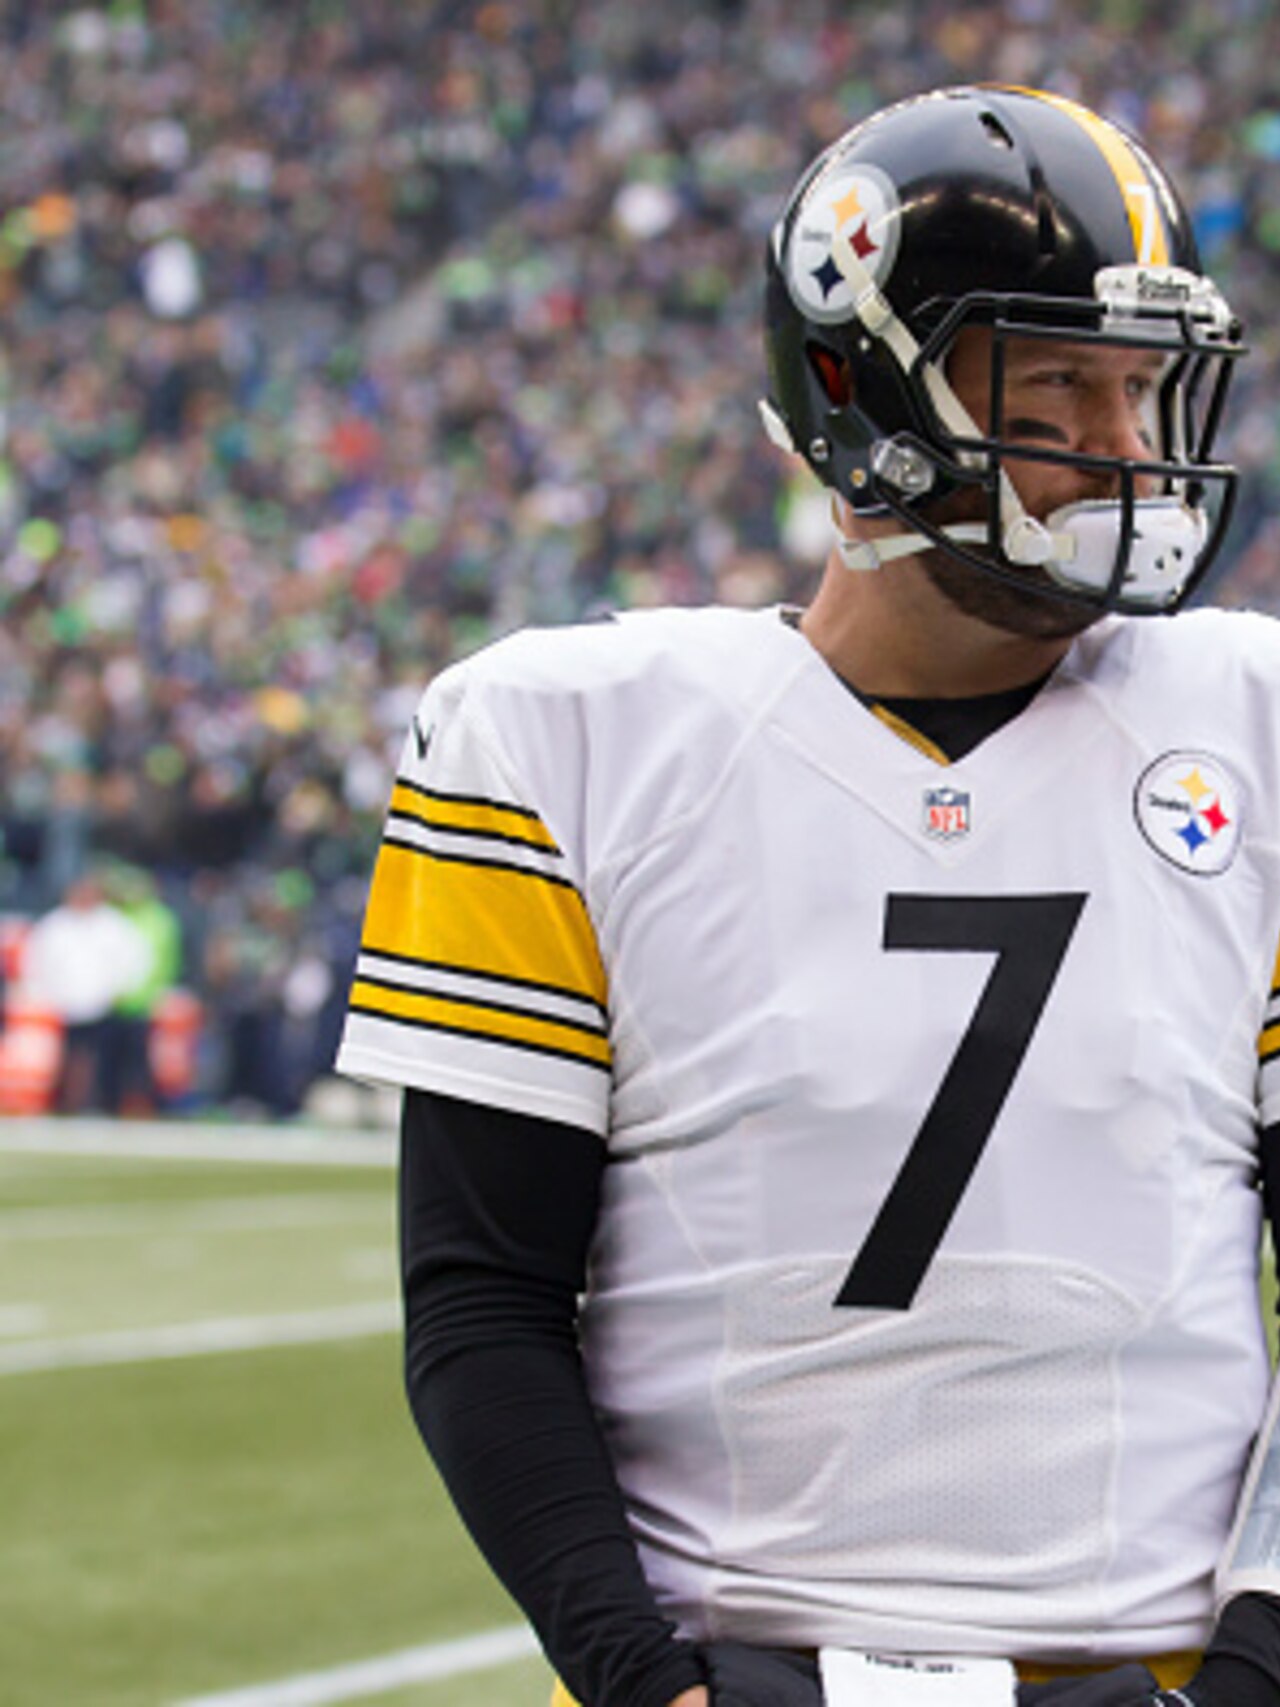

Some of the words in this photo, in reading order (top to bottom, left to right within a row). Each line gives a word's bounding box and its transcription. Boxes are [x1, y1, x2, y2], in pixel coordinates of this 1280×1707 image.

[1127, 183, 1155, 266] 7
[930, 806, 968, 832] NFL
[833, 893, 1089, 1310] 7
